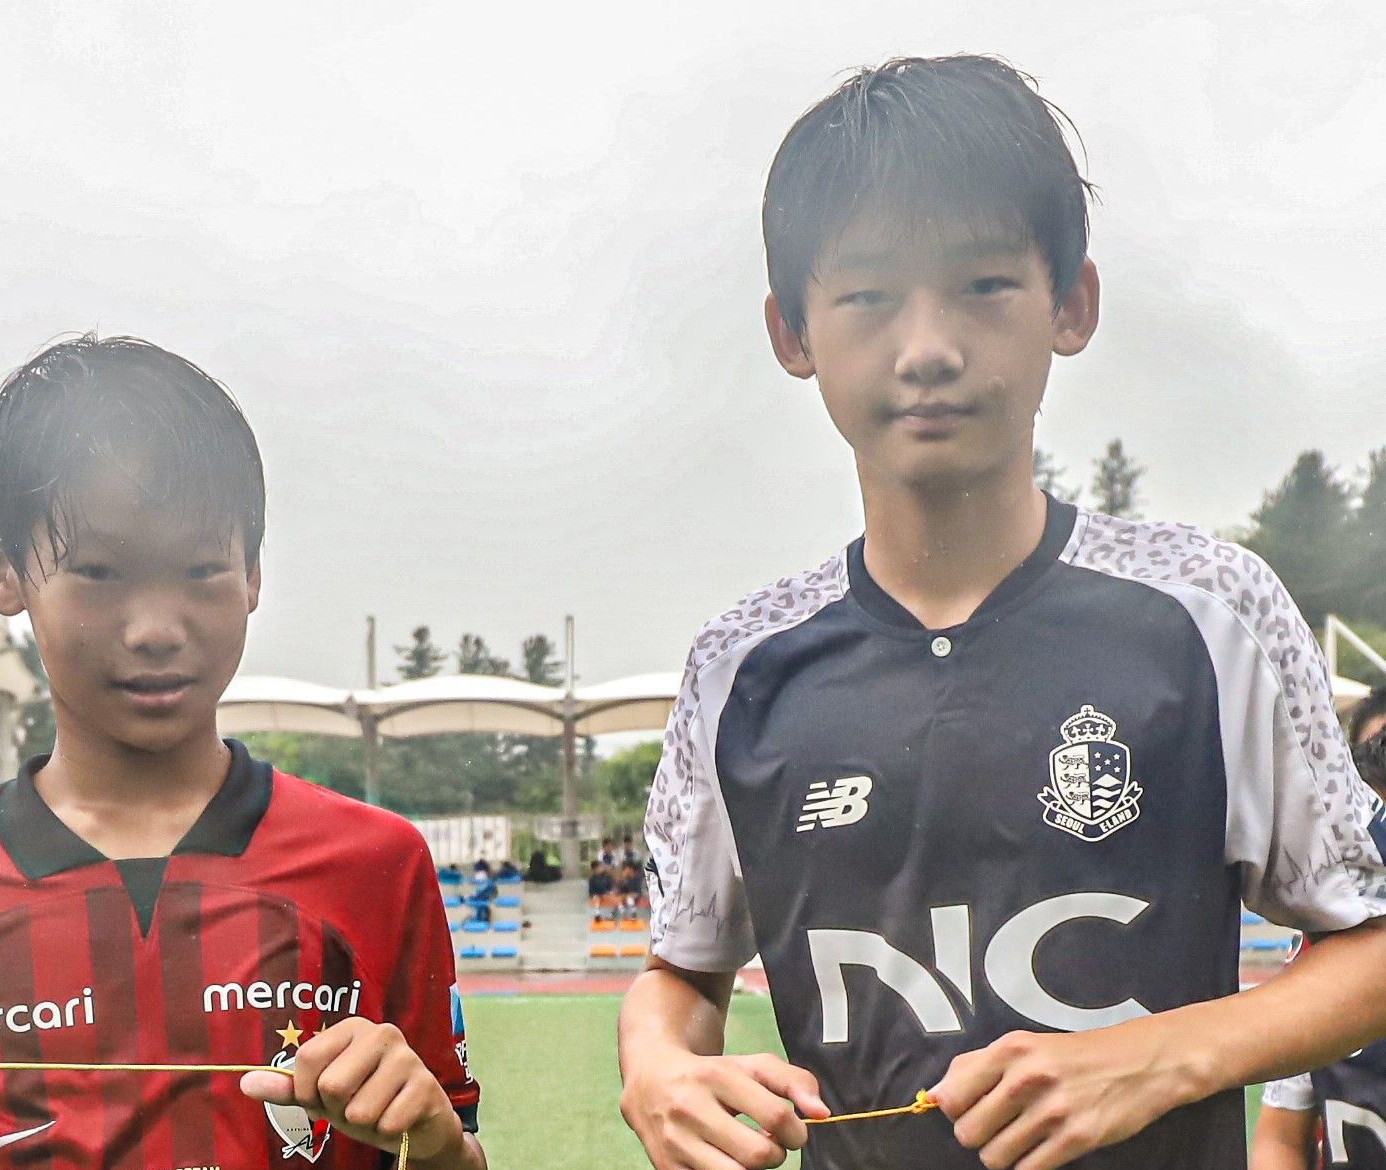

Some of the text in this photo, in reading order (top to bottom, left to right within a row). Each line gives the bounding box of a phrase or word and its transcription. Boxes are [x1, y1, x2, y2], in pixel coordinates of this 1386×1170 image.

[1054, 813, 1086, 834] SEOUL
[807, 892, 1151, 1045] NC
[203, 980, 362, 1015] mercari
